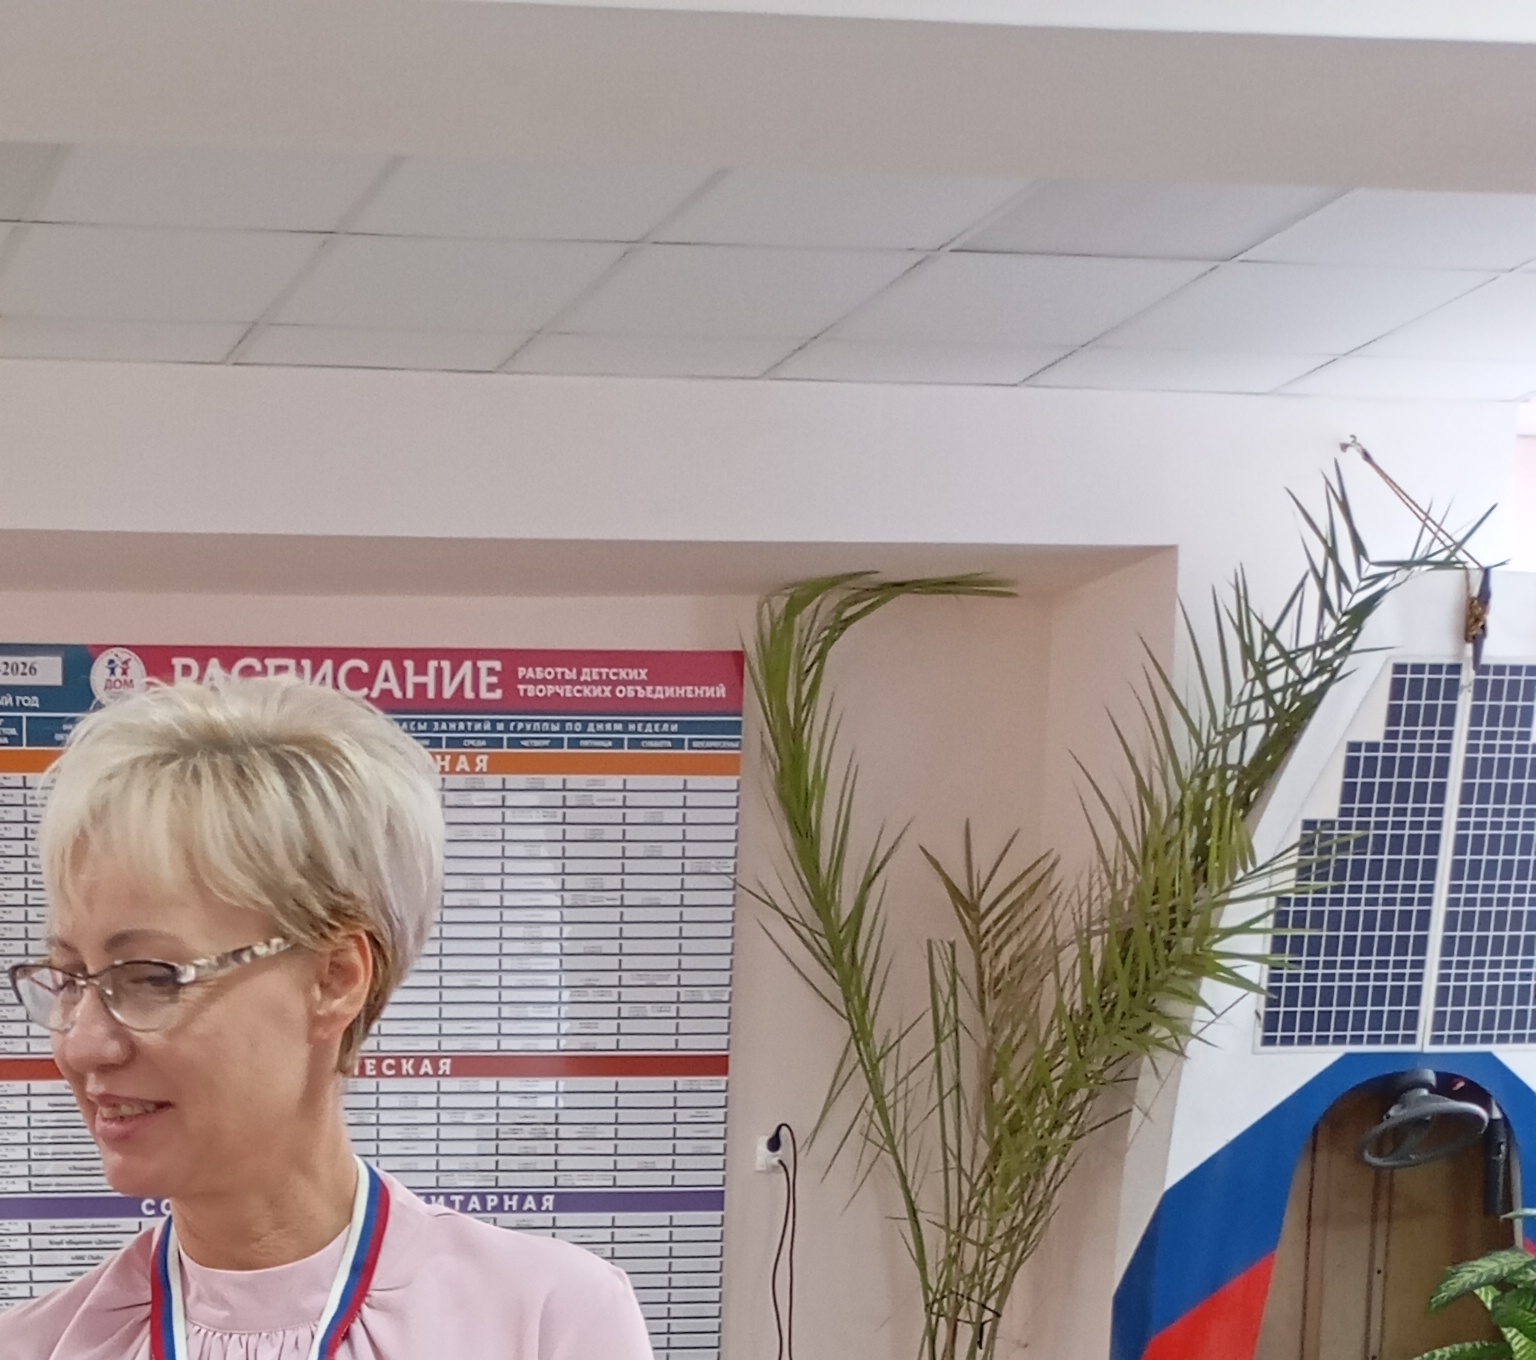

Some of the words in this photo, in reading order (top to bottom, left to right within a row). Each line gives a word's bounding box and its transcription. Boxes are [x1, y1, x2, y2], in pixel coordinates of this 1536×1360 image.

[517, 667, 577, 680] РАБОТЫ
[580, 668, 648, 682] ДЕТСКИХ
[104, 678, 135, 691] ДОМ
[517, 684, 612, 698] ТВОРЧЕСКИХ
[616, 683, 726, 699] ОБЪЕДИНЕНИЙ
[16, 696, 39, 708] ГОД
[398, 721, 428, 732] АСЫ
[432, 720, 491, 731] ЗАНЯТИЙ
[496, 721, 505, 731] И
[509, 721, 560, 732] ГРУППЫ
[565, 722, 582, 732] ПО
[586, 722, 623, 733] ДНЯМ
[628, 722, 679, 733] НЕДЕЛИ
[436, 754, 489, 772] НАЯ
[353, 1058, 452, 1076] ЕСКАЯ
[141, 1199, 172, 1216] СО
[418, 1194, 556, 1212] ИТАРНАЯ
